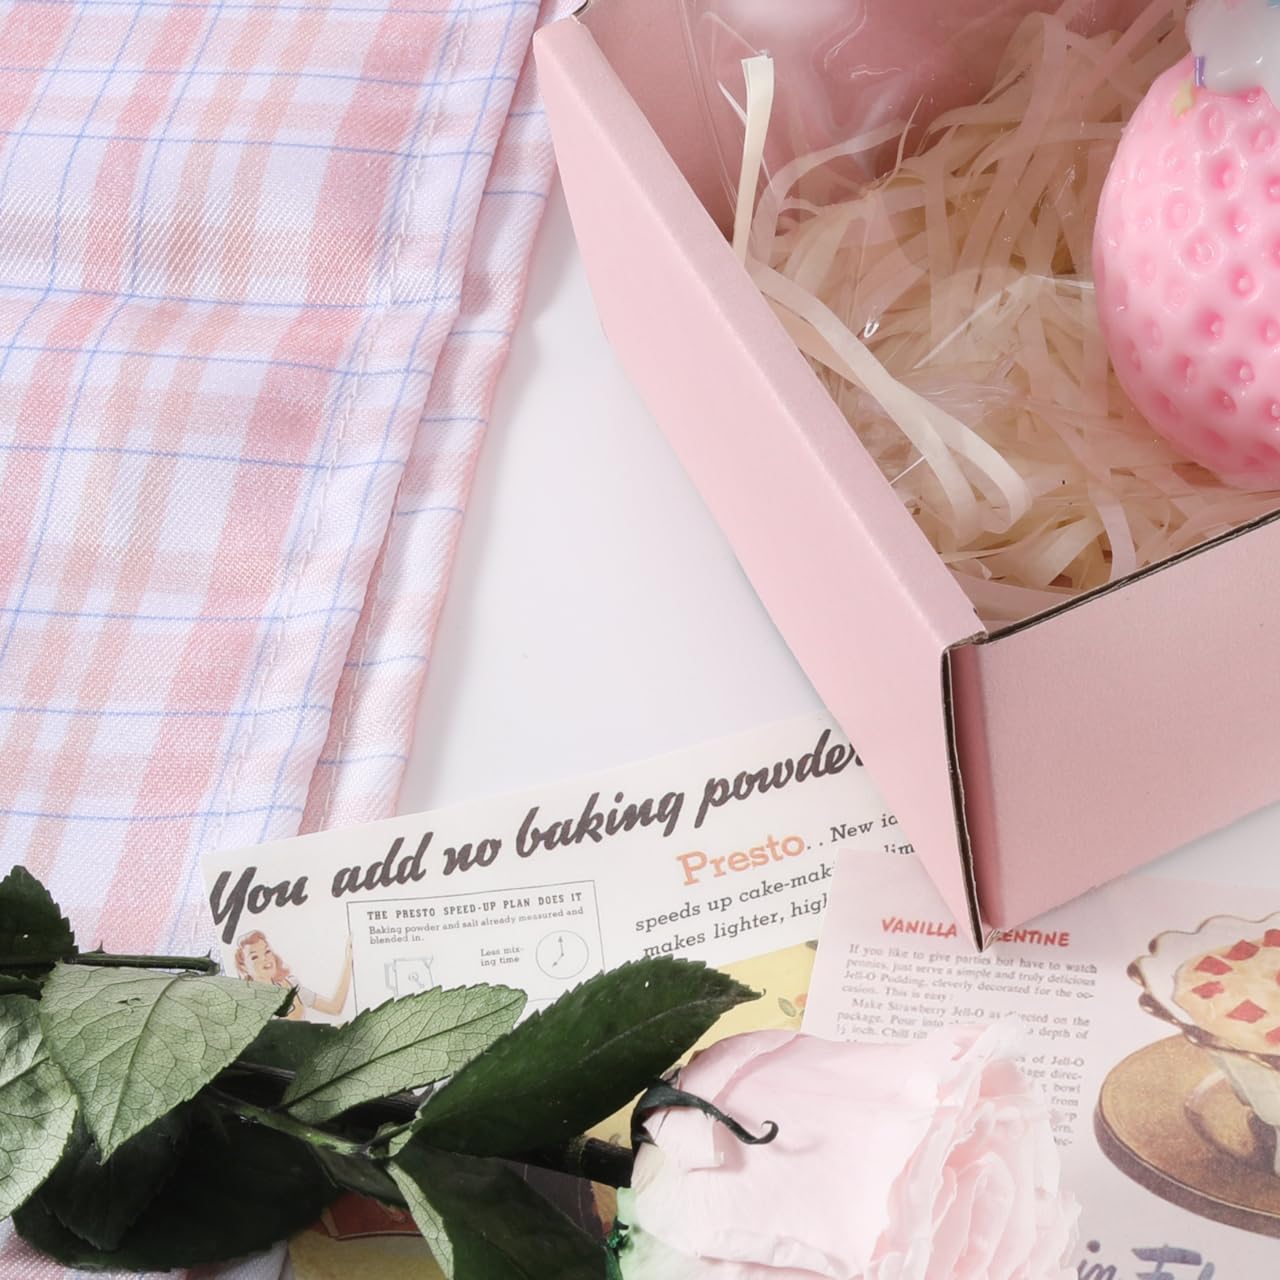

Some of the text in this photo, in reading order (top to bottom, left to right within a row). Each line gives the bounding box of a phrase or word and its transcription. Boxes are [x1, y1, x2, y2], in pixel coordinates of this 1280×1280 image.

[829, 820, 874, 843] New
[209, 866, 309, 945] You
[331, 831, 434, 898] add
[442, 838, 502, 876] no
[515, 791, 686, 858] baking
[366, 892, 582, 920] THE PRESTO SPEED-UP PLAN DOES IT
[635, 863, 834, 934] speeds up cake-mak
[369, 925, 402, 935] Baking
[405, 923, 440, 935] powder
[443, 920, 460, 930] and
[481, 915, 515, 926] already
[518, 909, 564, 922] measured
[566, 906, 584, 916] and
[881, 916, 958, 939] VANILLA
[370, 934, 408, 945] blended
[643, 933, 706, 958] makes
[713, 911, 785, 939] lighter,
[499, 956, 520, 965] time
[849, 943, 860, 954] If
[863, 947, 883, 957] you
[888, 947, 909, 959] like
[913, 951, 924, 960] to
[929, 951, 951, 963] give
[955, 953, 991, 965] parties
[1020, 957, 1045, 969] have
[1049, 961, 1060, 970] to
[1066, 963, 1098, 974] watch
[995, 970, 1015, 980] and
[1047, 974, 1096, 986] delicious
[977, 982, 1030, 994] decorated
[1035, 986, 1051, 996] for
[1055, 988, 1072, 998] the
[1072, 1015, 1091, 1027] the
[1039, 1026, 1071, 1040] depth
[1075, 1030, 1089, 1040] of
